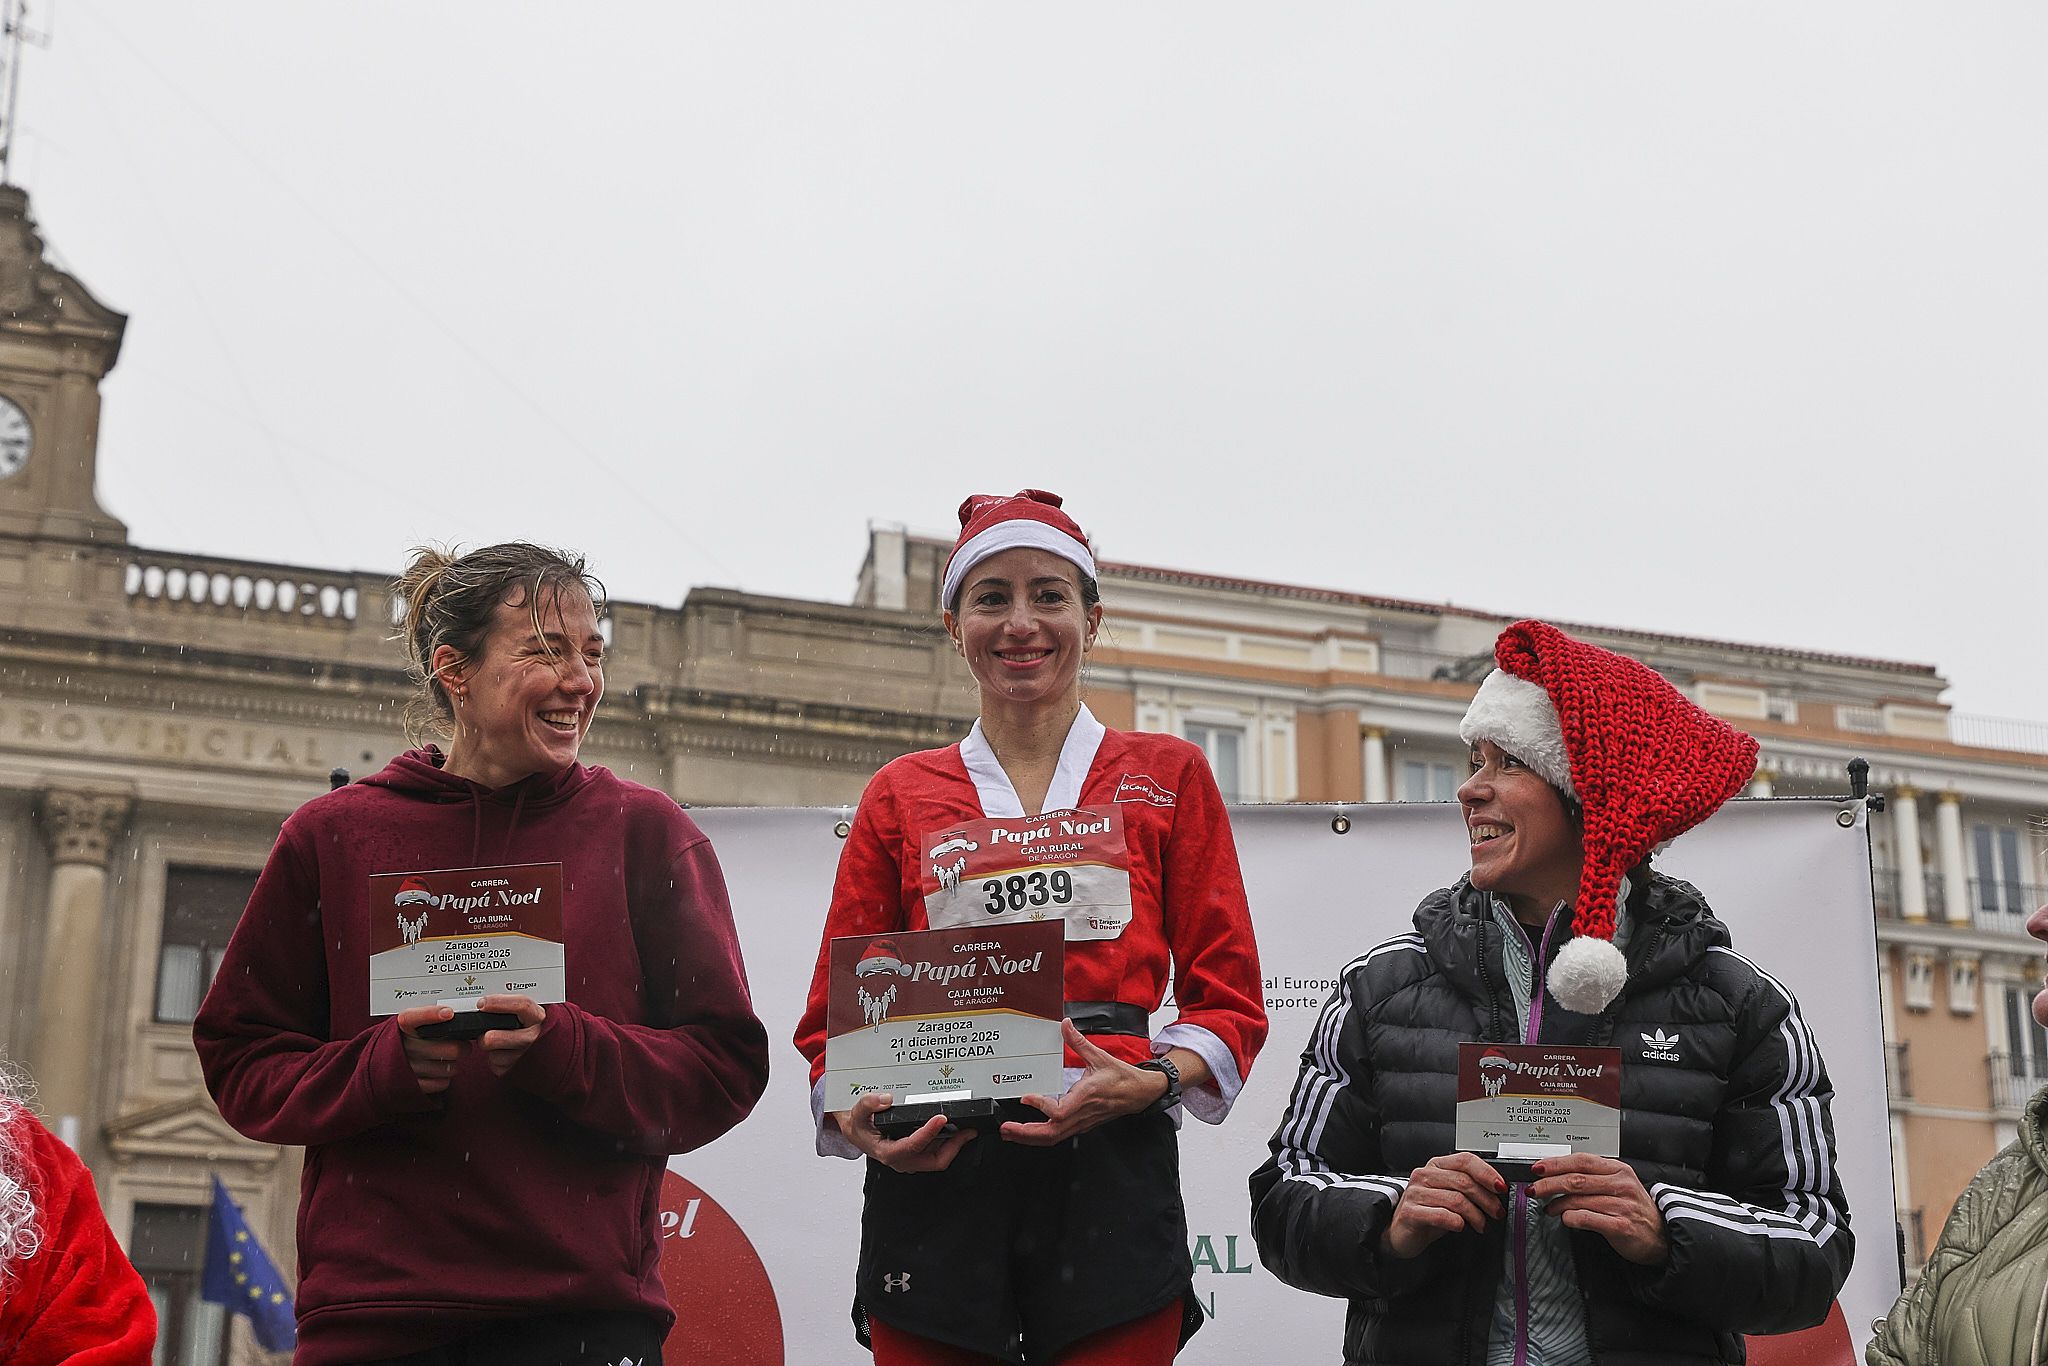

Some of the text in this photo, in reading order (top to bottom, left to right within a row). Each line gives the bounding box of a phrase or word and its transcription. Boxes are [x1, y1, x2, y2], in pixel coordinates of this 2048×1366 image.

[0, 707, 326, 767] ROVINCIAL
[1025, 811, 1071, 824] CARRERA
[989, 817, 1112, 846] Papá Noel
[1020, 842, 1084, 856] CAJA RURAL
[471, 878, 509, 888] CARRERA
[982, 870, 1074, 915] 3839
[439, 887, 542, 914] Papá Noel
[468, 914, 513, 924] CAJA RURAL
[445, 940, 489, 951] Zaragoza
[953, 942, 1001, 953] CARRERA
[425, 949, 511, 963] 21 diciembre 2025
[440, 960, 507, 973] CLASIFICADA
[911, 951, 1043, 986] Papá Noel
[513, 981, 537, 989] Zaragoza
[947, 986, 1005, 999] CAJA RURAL
[965, 996, 998, 1005] ARAGÓN
[1265, 998, 1317, 1010] eporte
[917, 1019, 973, 1035] Zaragoza
[890, 1030, 1000, 1049] 21 diciembre 2025
[909, 1045, 995, 1062] CLASIFICADA
[1642, 1050, 1680, 1062] adidas
[1516, 1061, 1603, 1079] Papá Noel
[928, 1077, 965, 1086] CAJA RURAL
[1002, 1073, 1033, 1082] Zaragoza
[1522, 1099, 1556, 1107] Zaragoza
[1516, 1107, 1552, 1115] diciembre
[1554, 1108, 1571, 1116] 2025
[1517, 1115, 1568, 1124] CLASIFICADA
